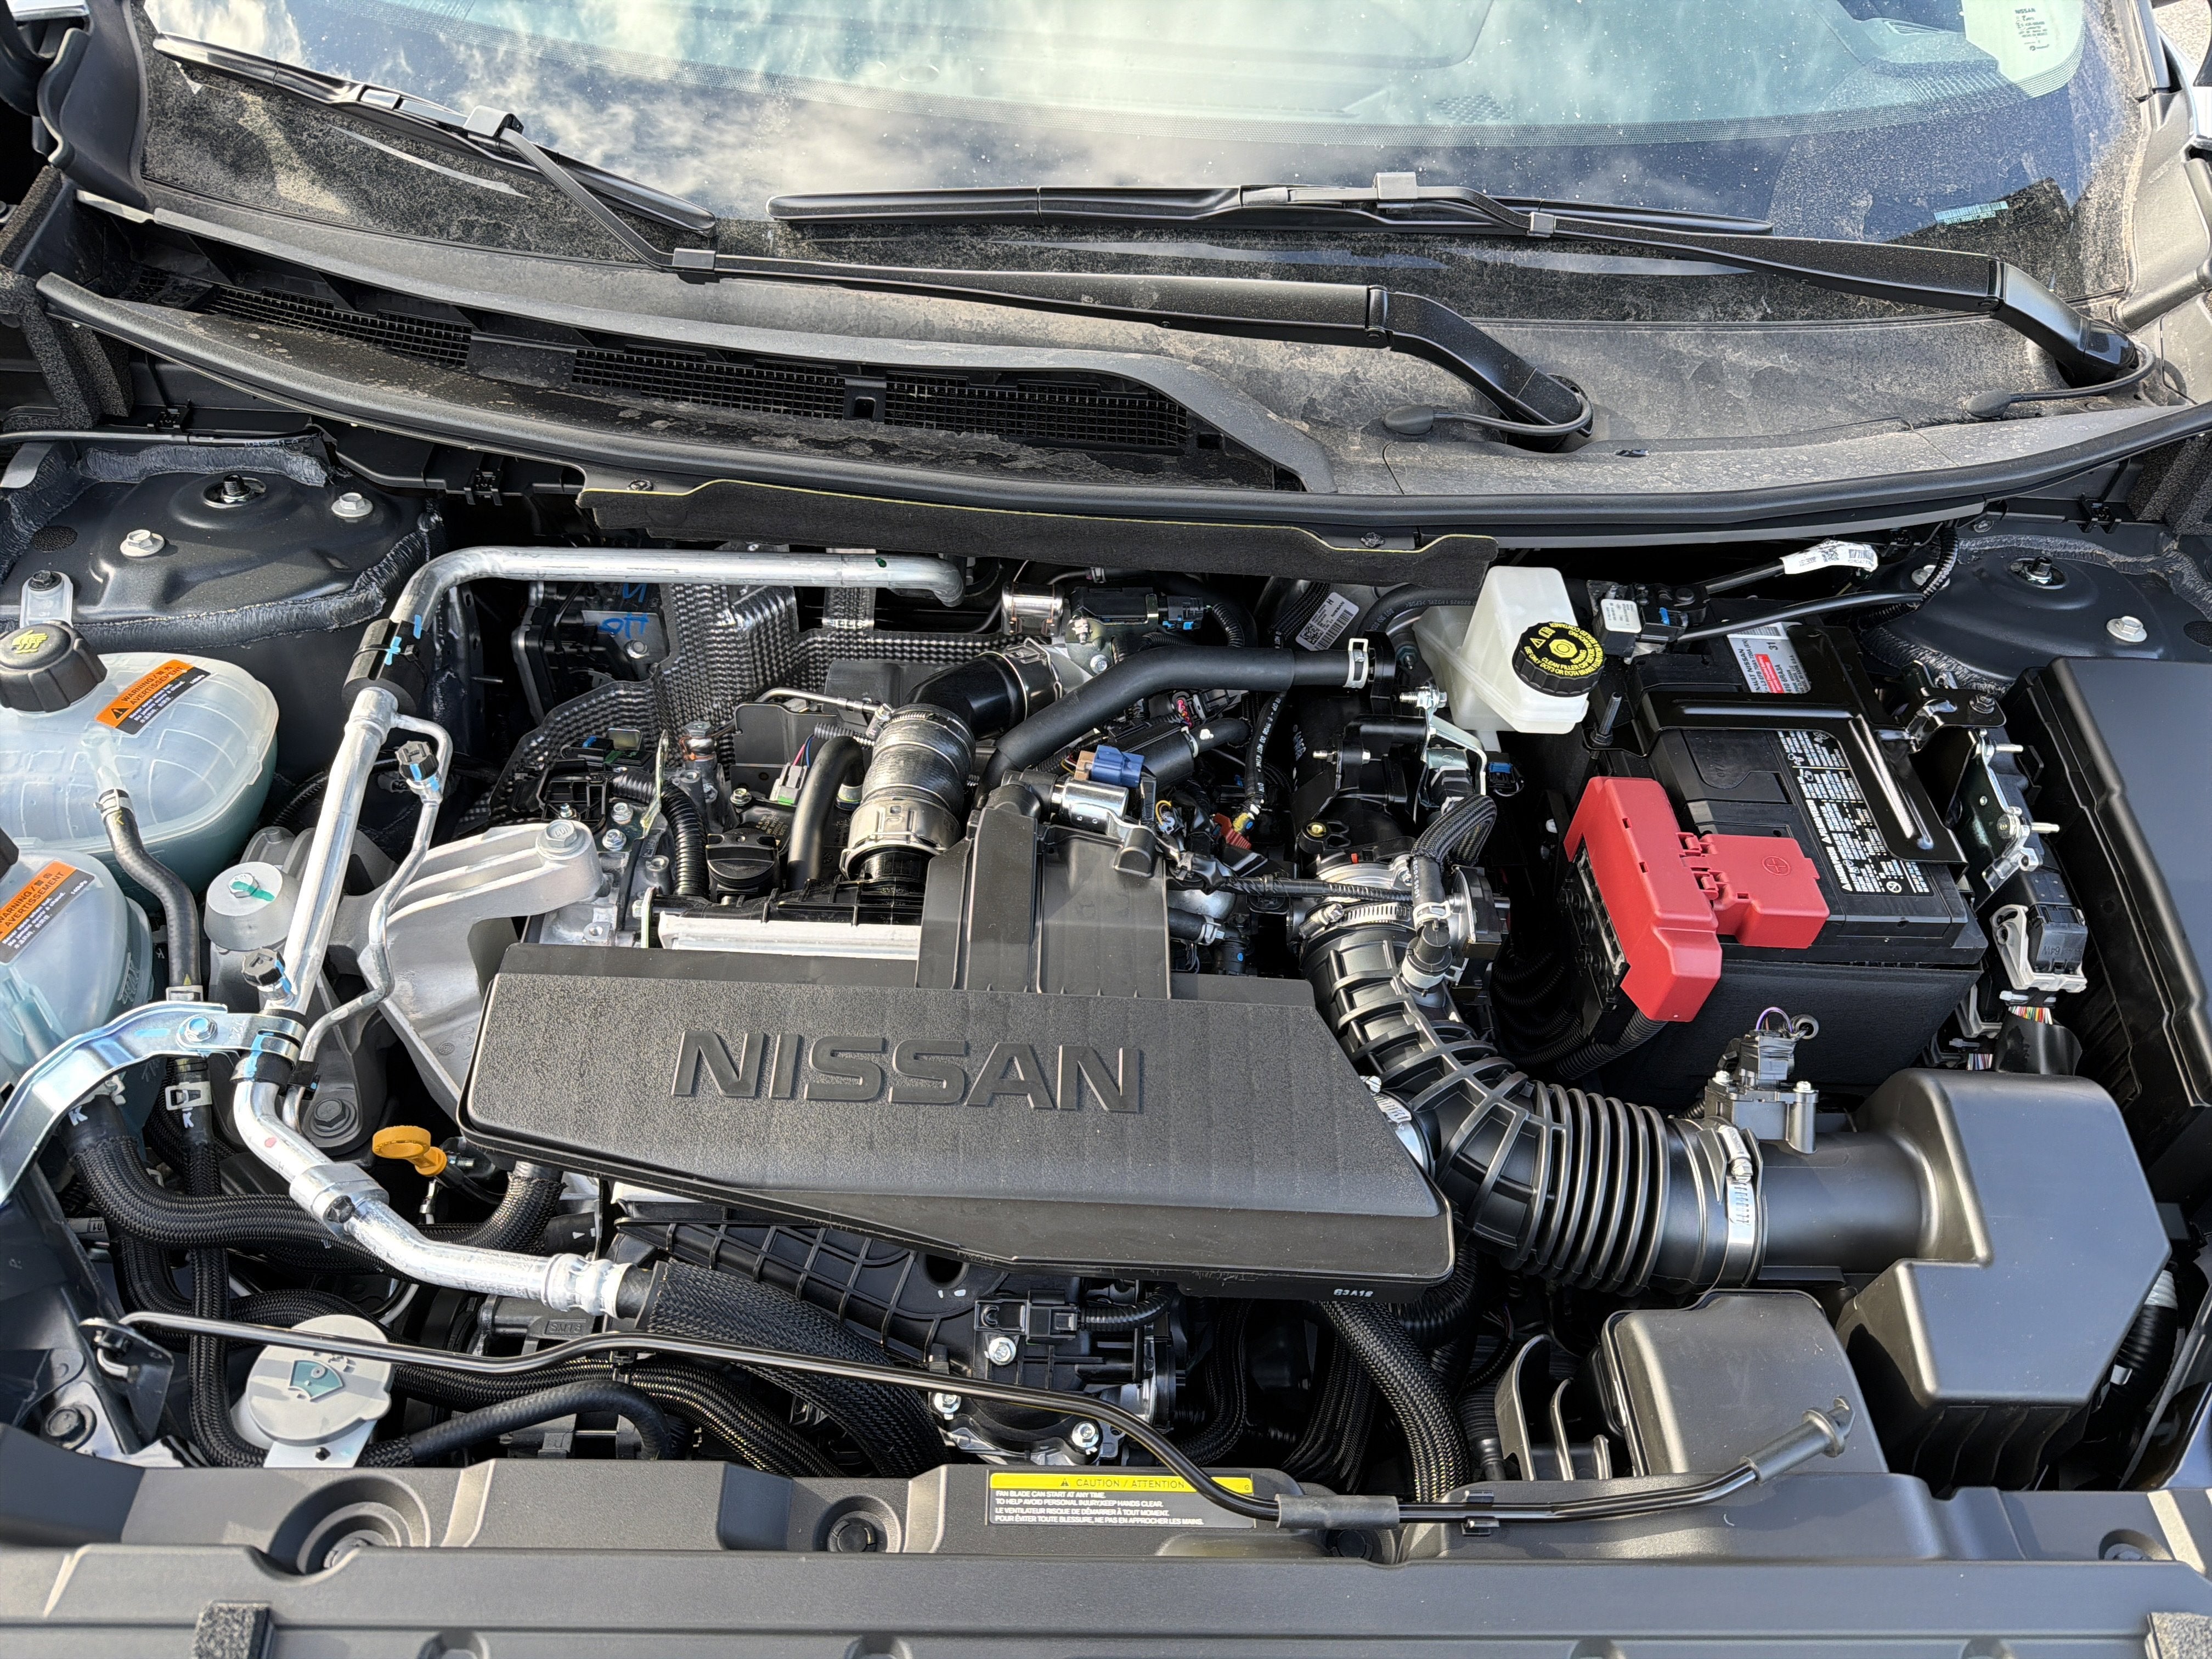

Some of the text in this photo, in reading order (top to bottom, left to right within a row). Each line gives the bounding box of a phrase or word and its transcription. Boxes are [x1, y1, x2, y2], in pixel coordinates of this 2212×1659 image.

[1539, 662, 1555, 673] DOT3
[1549, 622, 1580, 632] CONTAINER
[1766, 642, 1778, 650] 31
[1542, 657, 1561, 668] CLEAN
[1737, 648, 1753, 672] NISSAN
[121, 677, 154, 703] WARNING
[129, 666, 184, 706] AVERTISSEMENT
[1825, 846, 1849, 883] DANGER/POISON
[1886, 861, 1897, 875] FLAMES
[0, 889, 32, 924] WARNING
[5, 871, 65, 927] AVERTISSEMENT
[672, 1030, 1144, 1114] NISSAN
[1076, 1479, 1120, 1488] CAUTION
[1132, 1479, 1184, 1489] ATTENTION
[1014, 1514, 1037, 1523] ÉVITER
[1059, 1516, 1094, 1524] BLESSURE,
[1081, 1507, 1116, 1516] DÉMARRER
